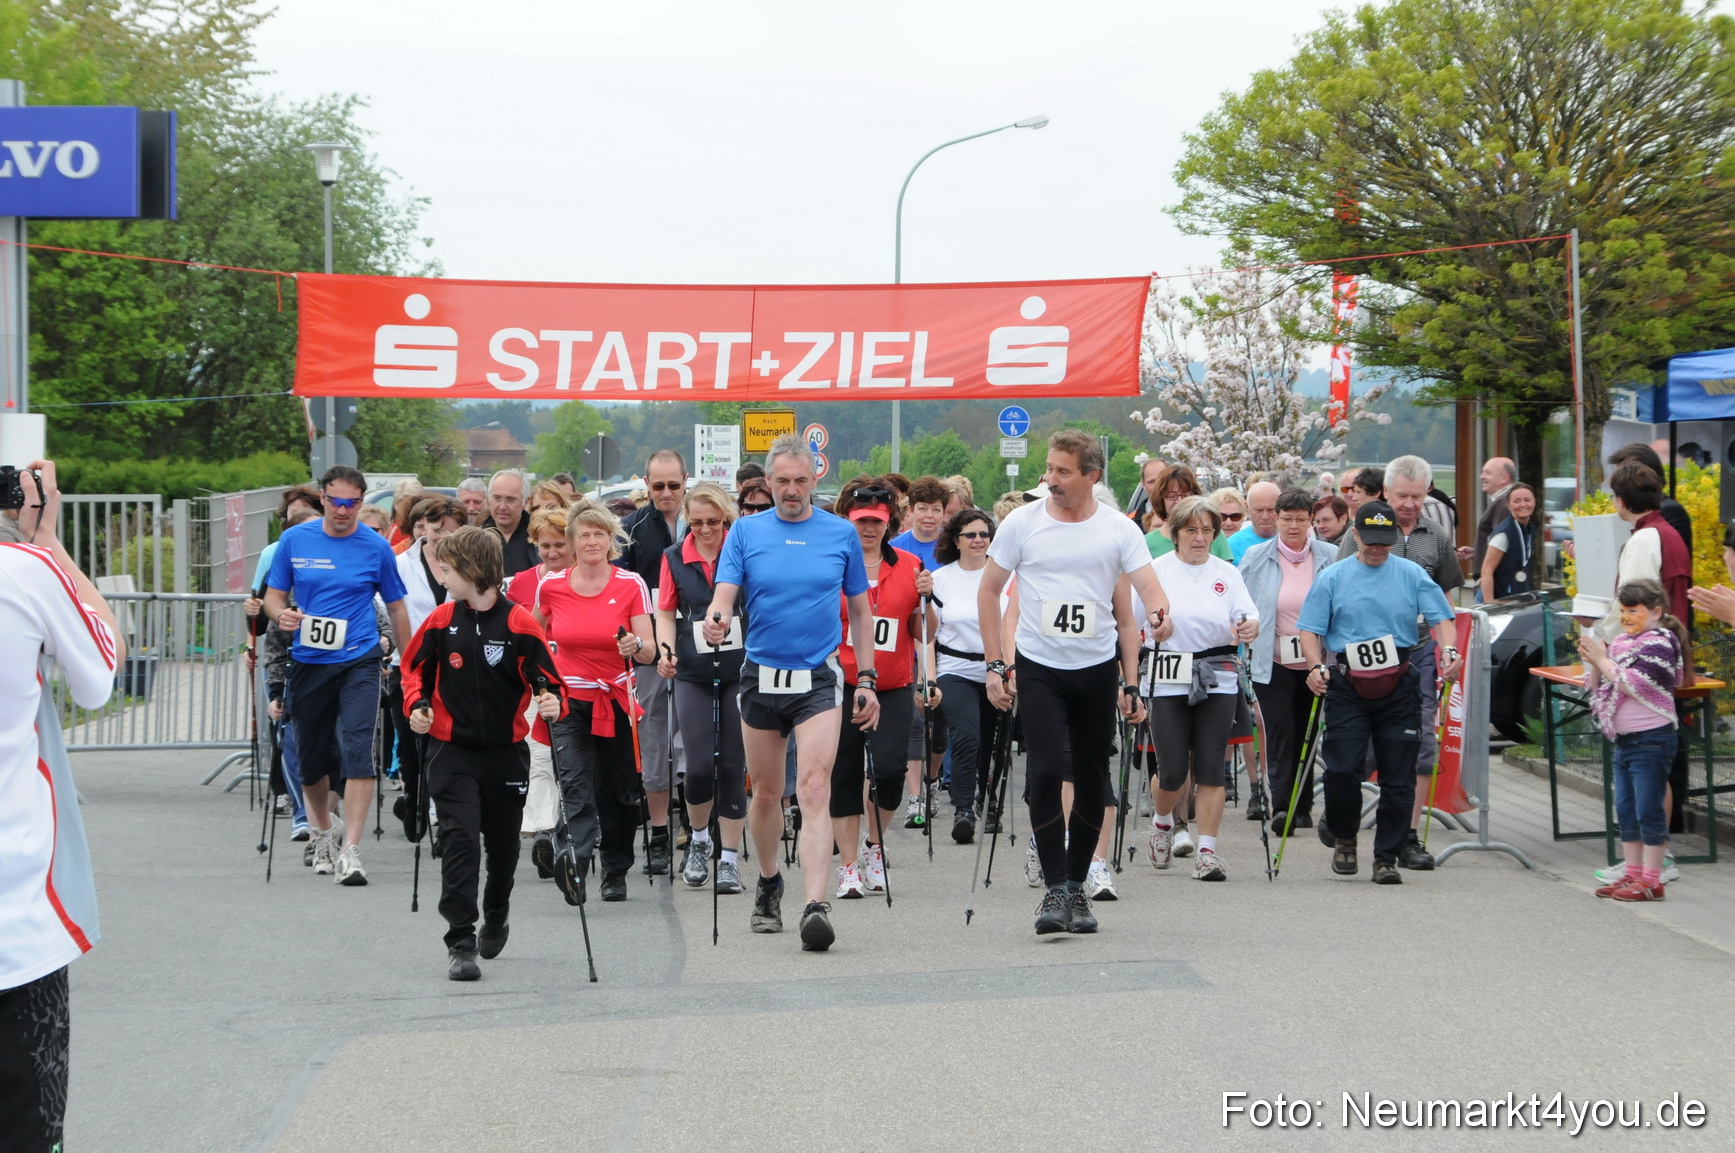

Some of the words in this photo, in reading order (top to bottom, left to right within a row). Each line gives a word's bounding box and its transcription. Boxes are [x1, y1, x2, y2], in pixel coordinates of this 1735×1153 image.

[749, 426, 791, 437] Neumarkt
[809, 431, 823, 444] 60
[310, 618, 337, 646] 50
[874, 618, 890, 646] 0
[1053, 603, 1085, 634] 45
[1157, 654, 1182, 680] 117
[1356, 639, 1388, 668] 89
